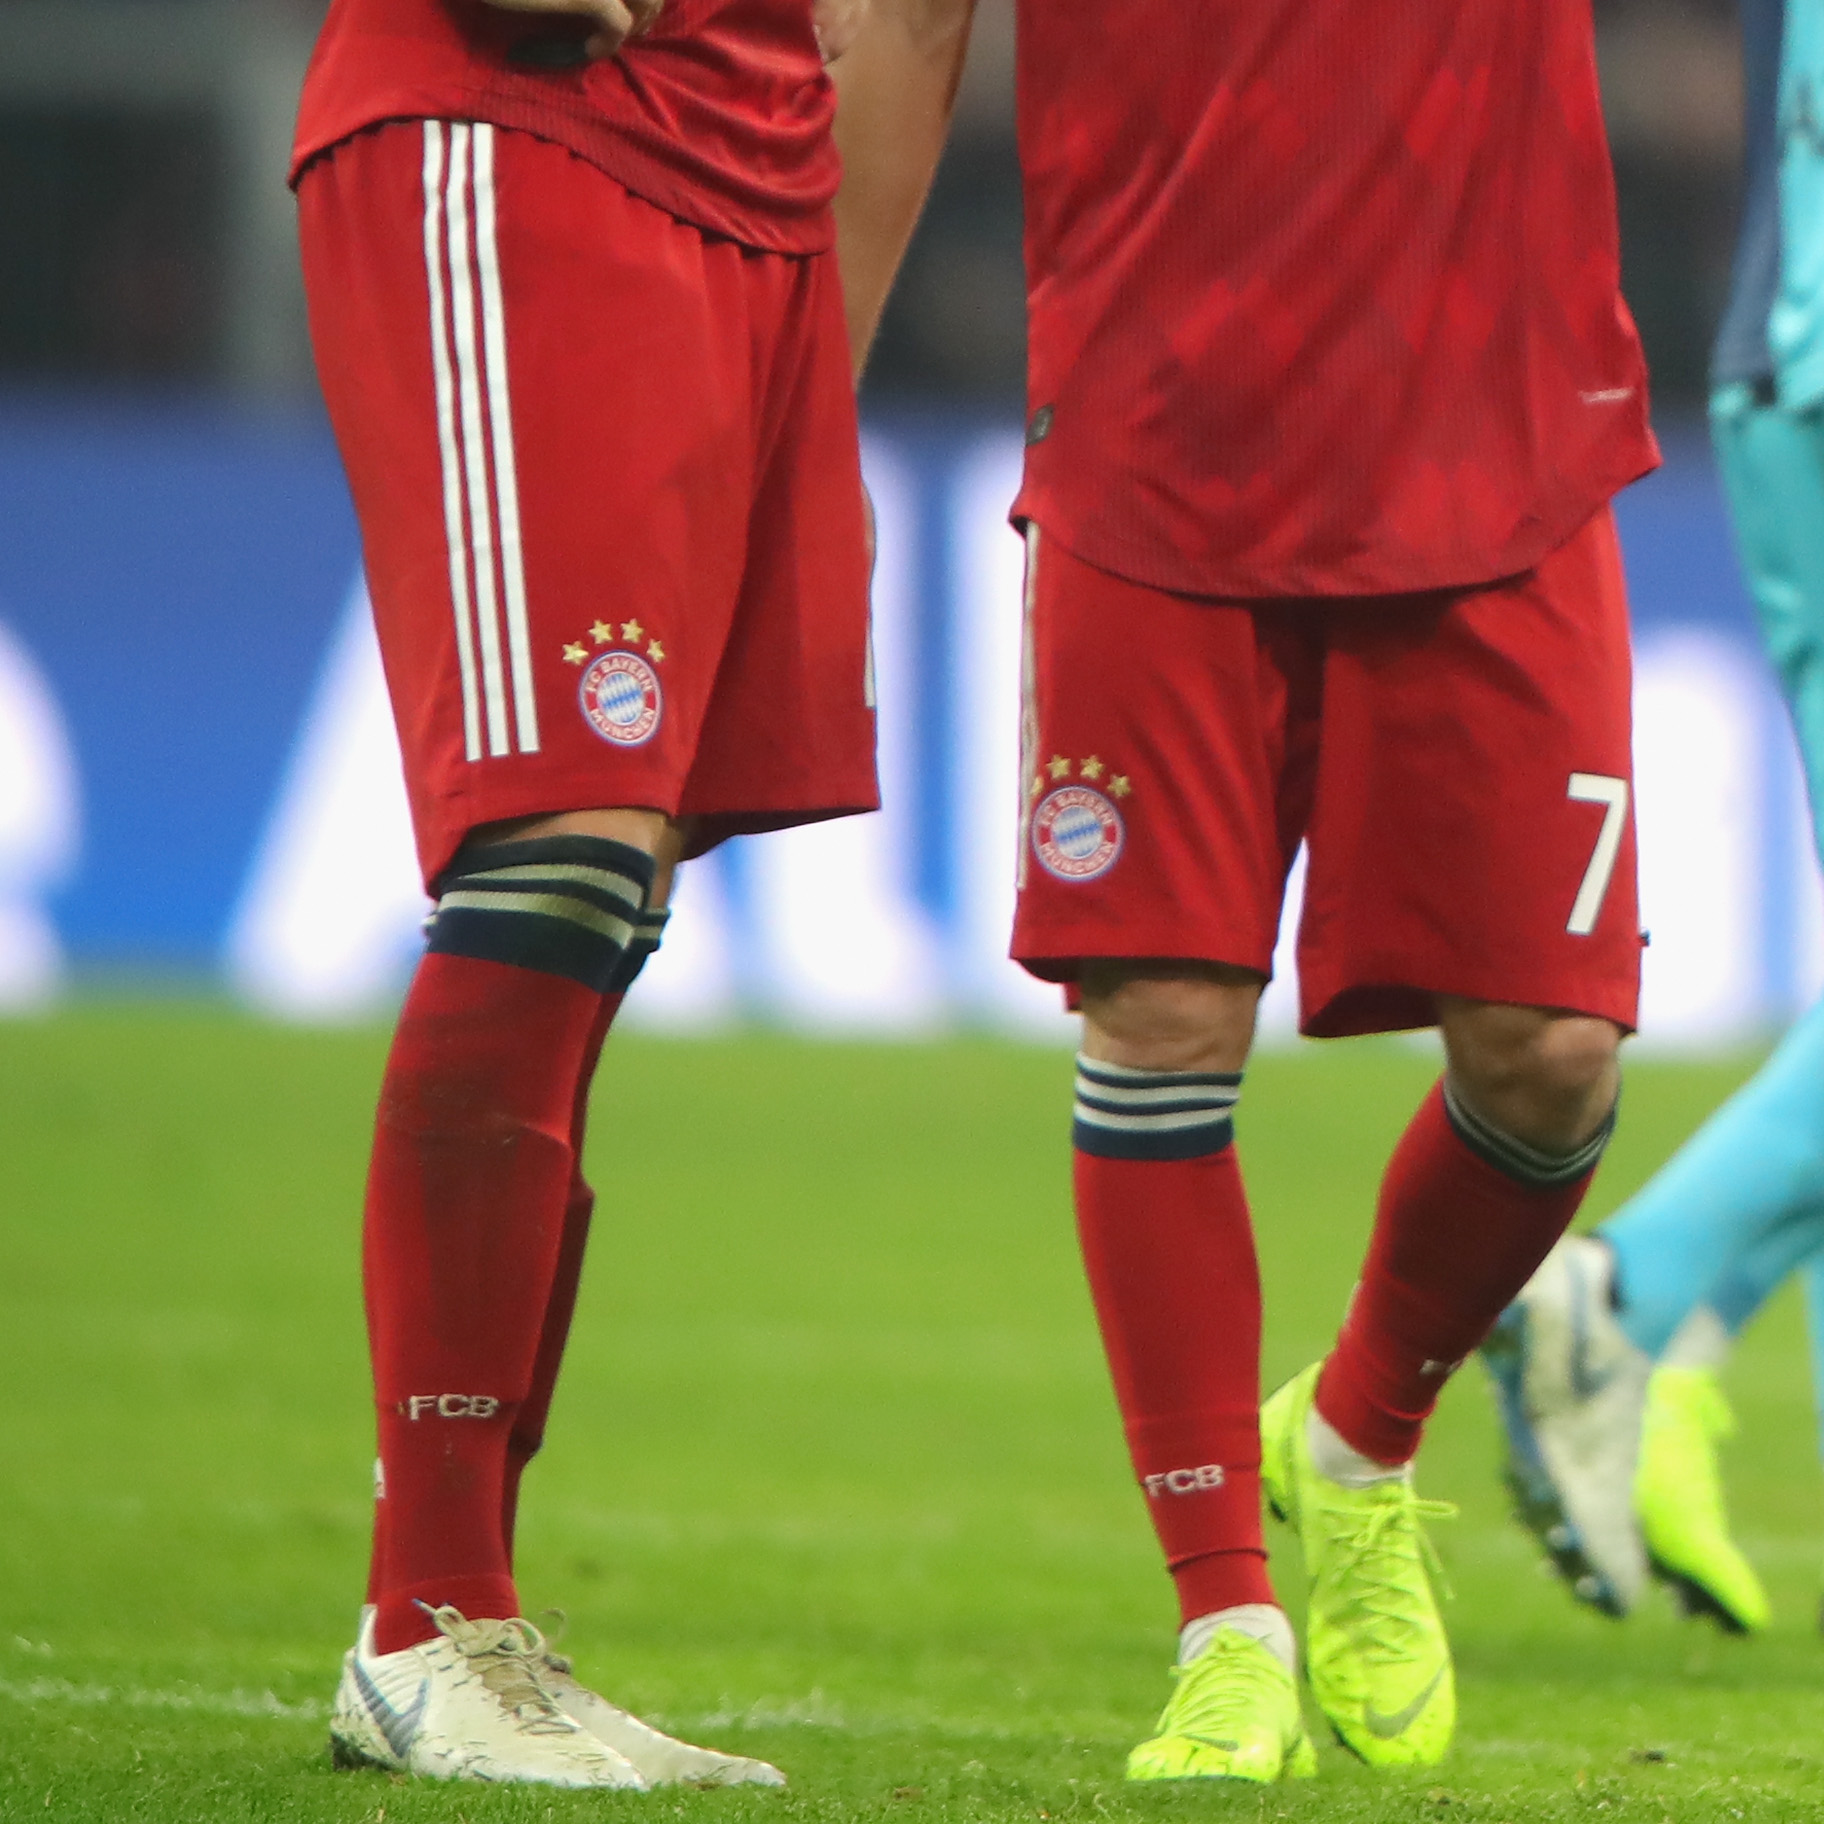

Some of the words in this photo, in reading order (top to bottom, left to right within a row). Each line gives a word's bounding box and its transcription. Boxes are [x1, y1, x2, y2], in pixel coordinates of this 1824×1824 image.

[601, 657, 654, 692] BAYERN
[1565, 772, 1628, 936] 7
[408, 1392, 499, 1421] FCB
[1144, 1463, 1226, 1498] FCB
